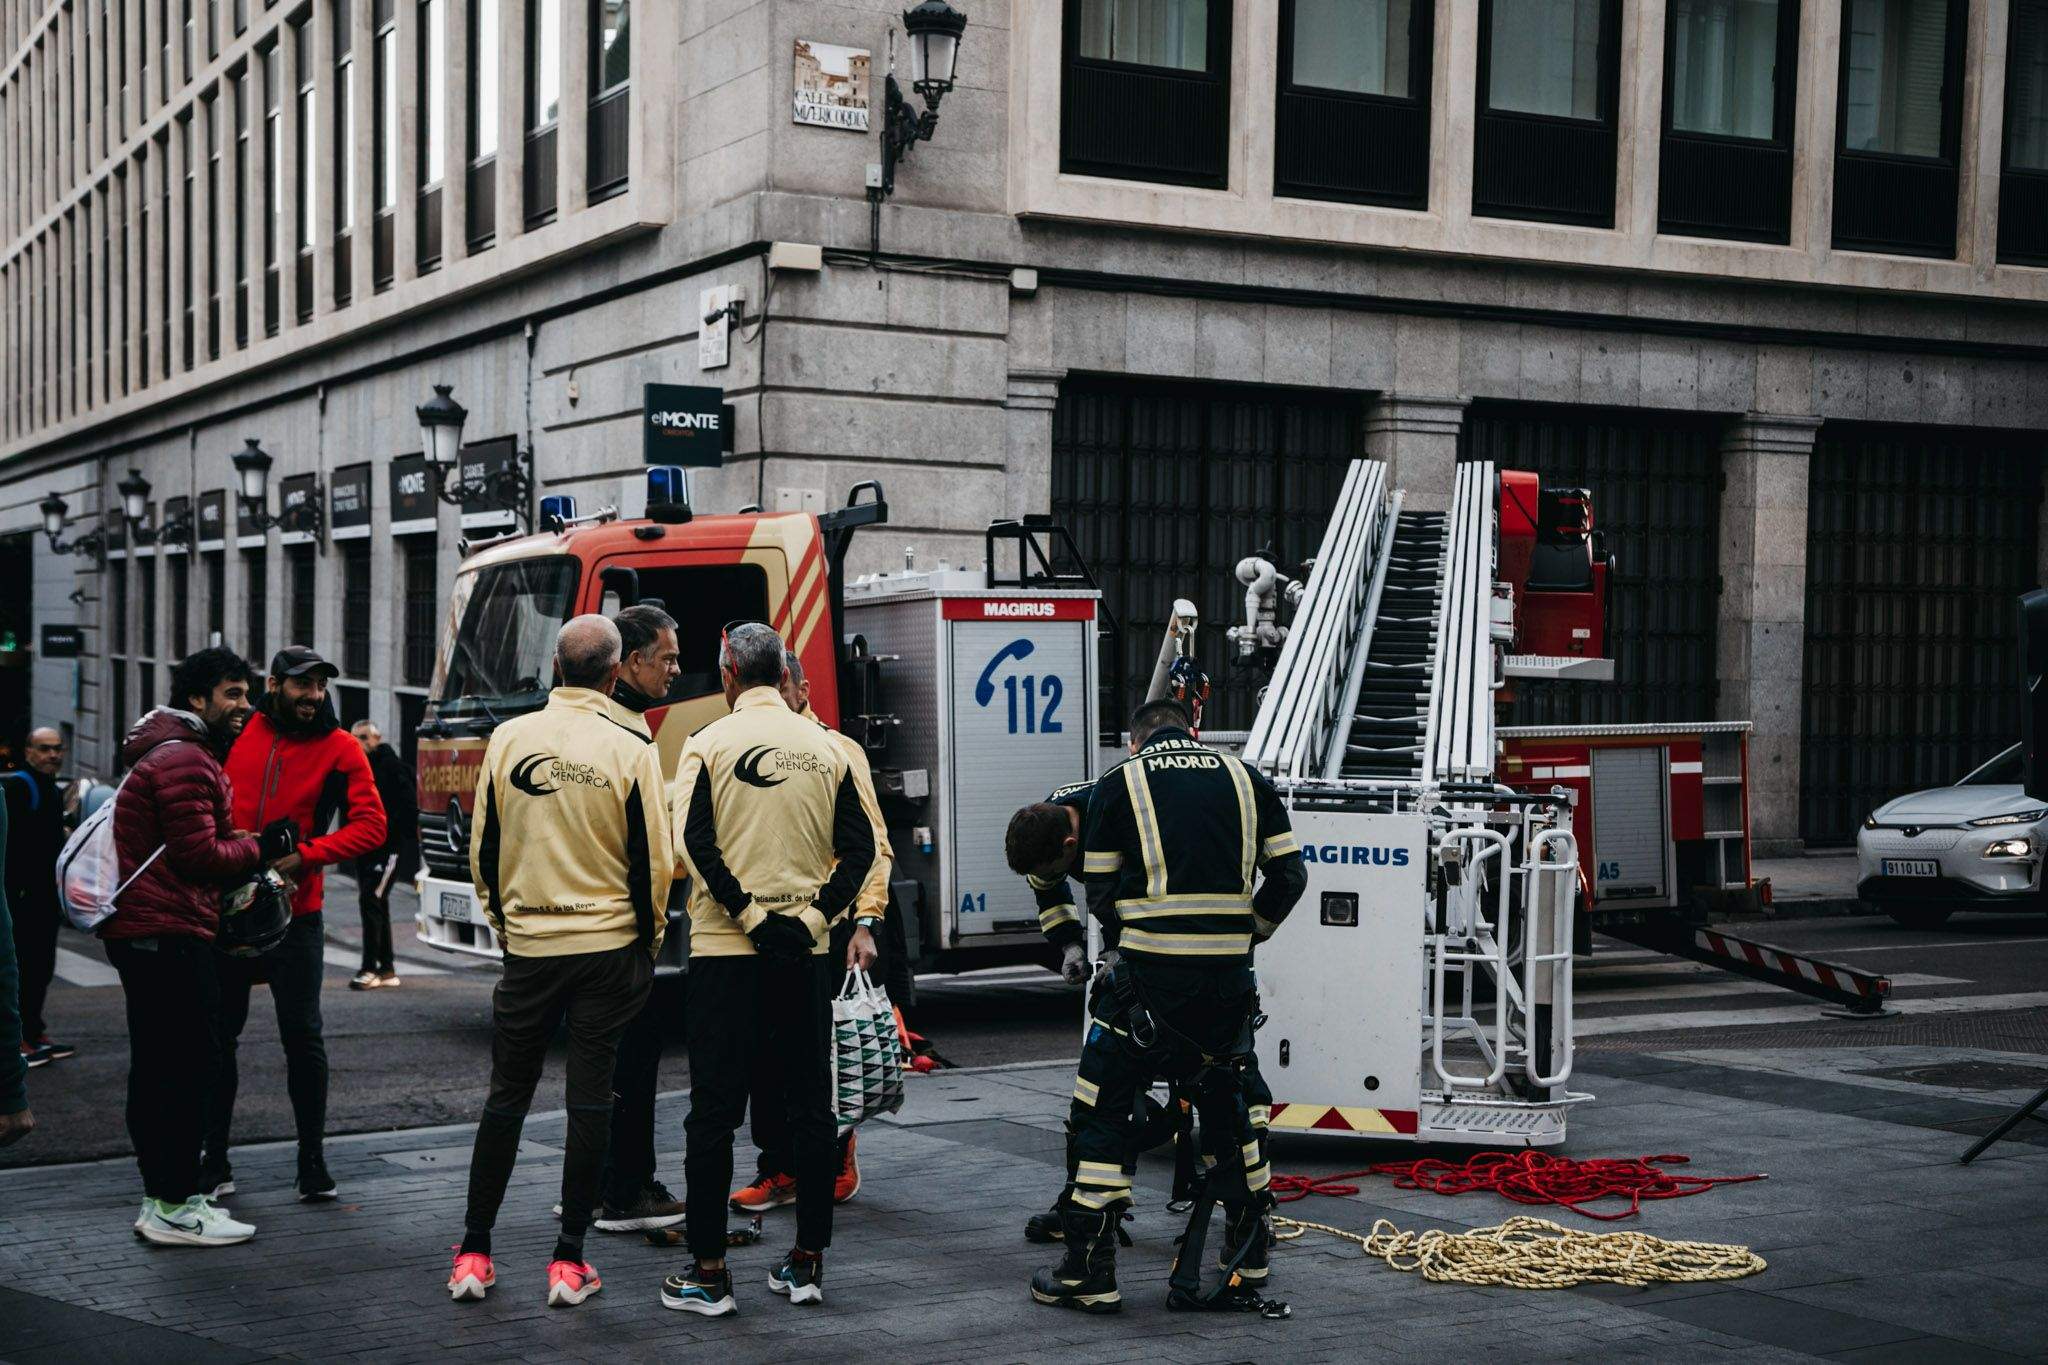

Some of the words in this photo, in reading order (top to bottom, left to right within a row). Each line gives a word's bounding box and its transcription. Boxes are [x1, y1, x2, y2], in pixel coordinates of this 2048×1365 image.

[794, 90, 832, 106] CALLE
[838, 96, 850, 107] DE
[853, 97, 867, 109] LA
[794, 102, 869, 129] MISERICORDIA
[984, 602, 1055, 616] MAGIRUS
[1004, 674, 1063, 735] 112
[775, 750, 818, 761] CLÍNICA
[1147, 755, 1220, 772] MADRID
[551, 760, 595, 776] CLÍNICA
[775, 760, 832, 775] MENORCA
[550, 770, 611, 790] MENORCA
[1301, 845, 1409, 866] AGIRUS
[1598, 861, 1620, 880] A5
[1888, 861, 1912, 875] 9110
[1914, 862, 1934, 875] LLX
[960, 892, 986, 912] A1
